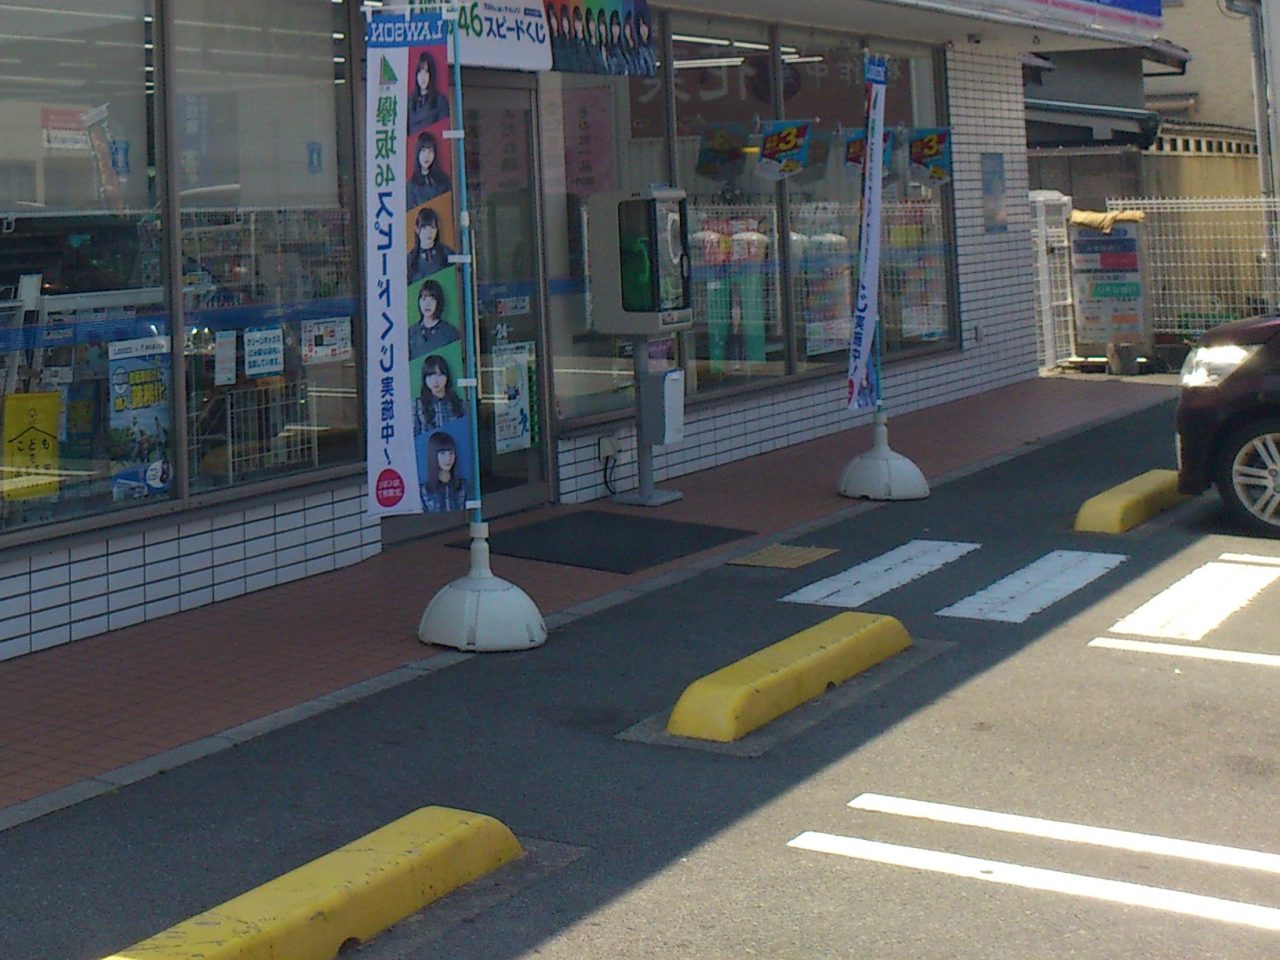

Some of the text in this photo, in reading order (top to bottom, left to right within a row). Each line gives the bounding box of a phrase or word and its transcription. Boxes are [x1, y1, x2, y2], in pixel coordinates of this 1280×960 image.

[484, 16, 546, 44] スピードくじ
[17, 439, 50, 451] こども
